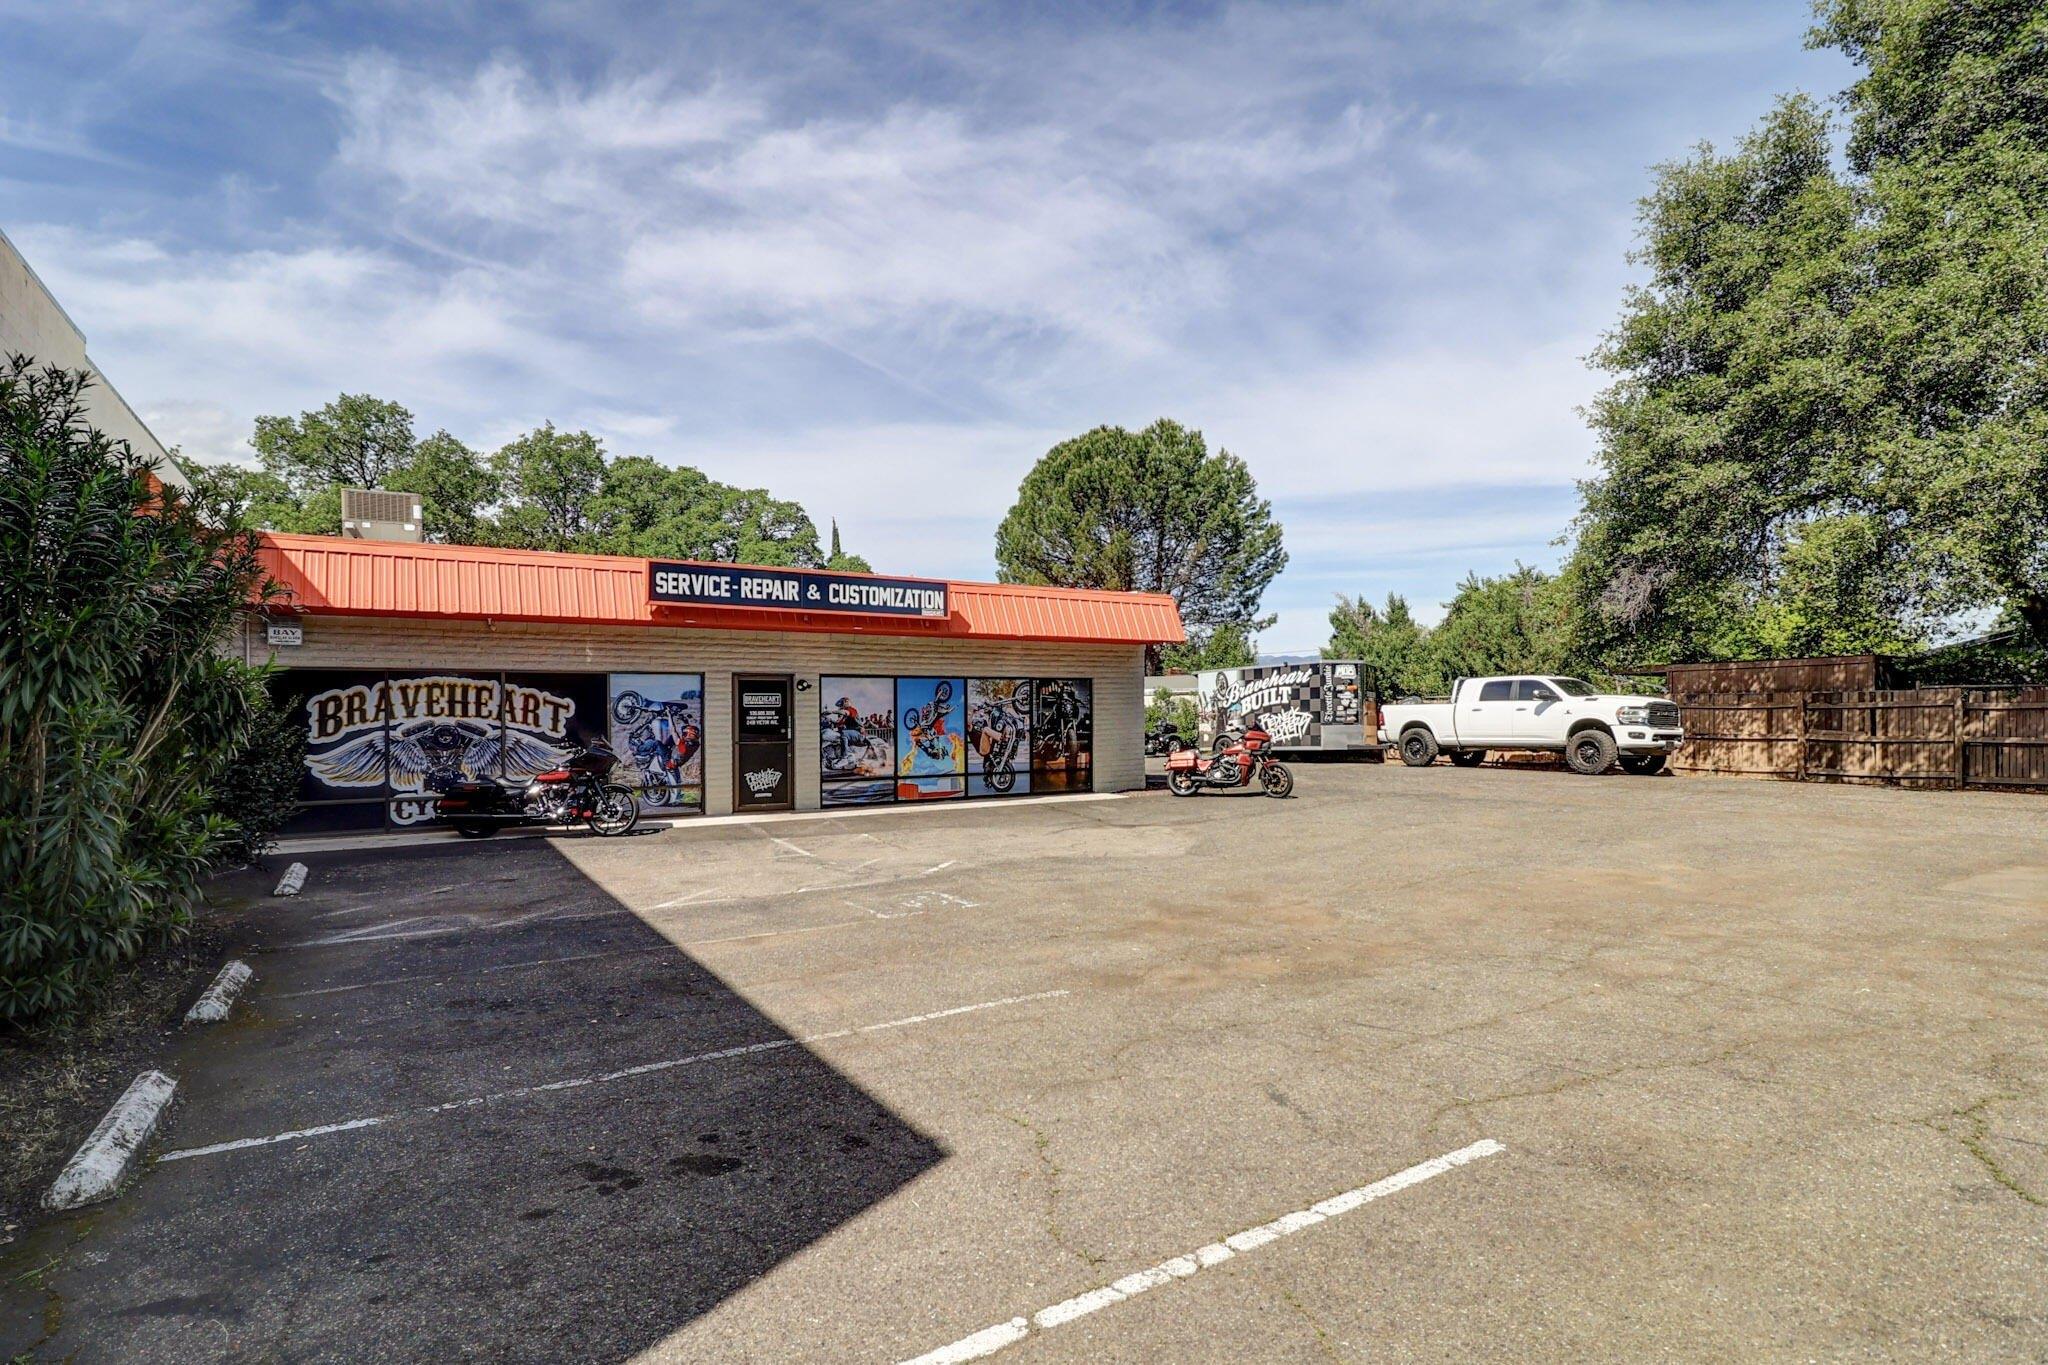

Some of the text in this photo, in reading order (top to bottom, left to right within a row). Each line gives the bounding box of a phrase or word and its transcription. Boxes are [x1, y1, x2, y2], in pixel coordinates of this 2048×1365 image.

[806, 583, 821, 600] &
[828, 583, 945, 609] CUSTOMIZATION
[1223, 668, 1313, 708] Braveheart
[1241, 686, 1292, 716] BUILT
[311, 680, 572, 740] BRAVEHEART
